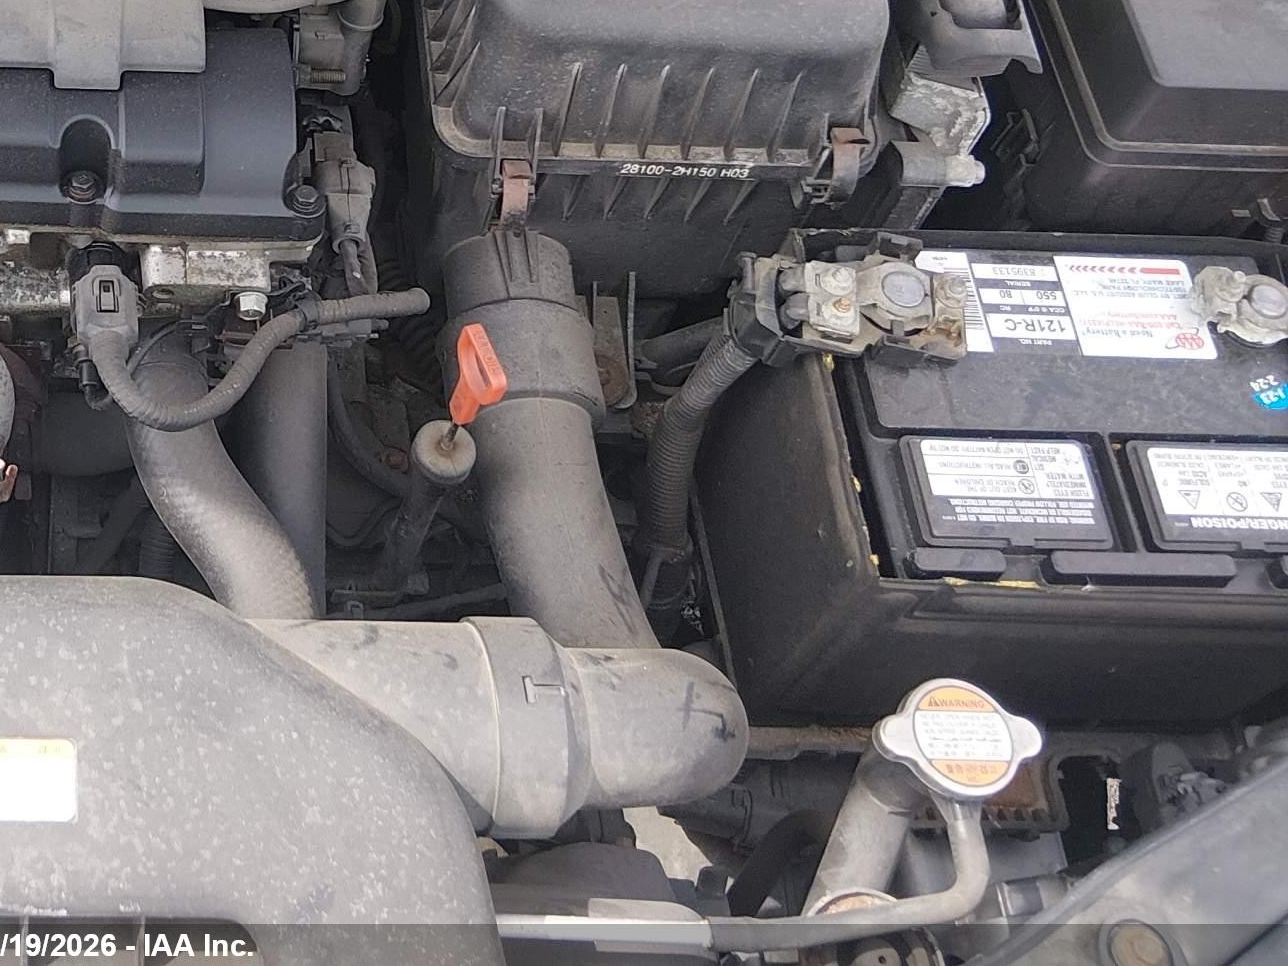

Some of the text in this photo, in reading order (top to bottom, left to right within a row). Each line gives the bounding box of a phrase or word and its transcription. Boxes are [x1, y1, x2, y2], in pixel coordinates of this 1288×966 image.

[619, 164, 717, 178] 28100-2H150
[1035, 290, 1056, 299] 550
[1004, 317, 1065, 332] 121R-C
[940, 698, 984, 709] WARNING
